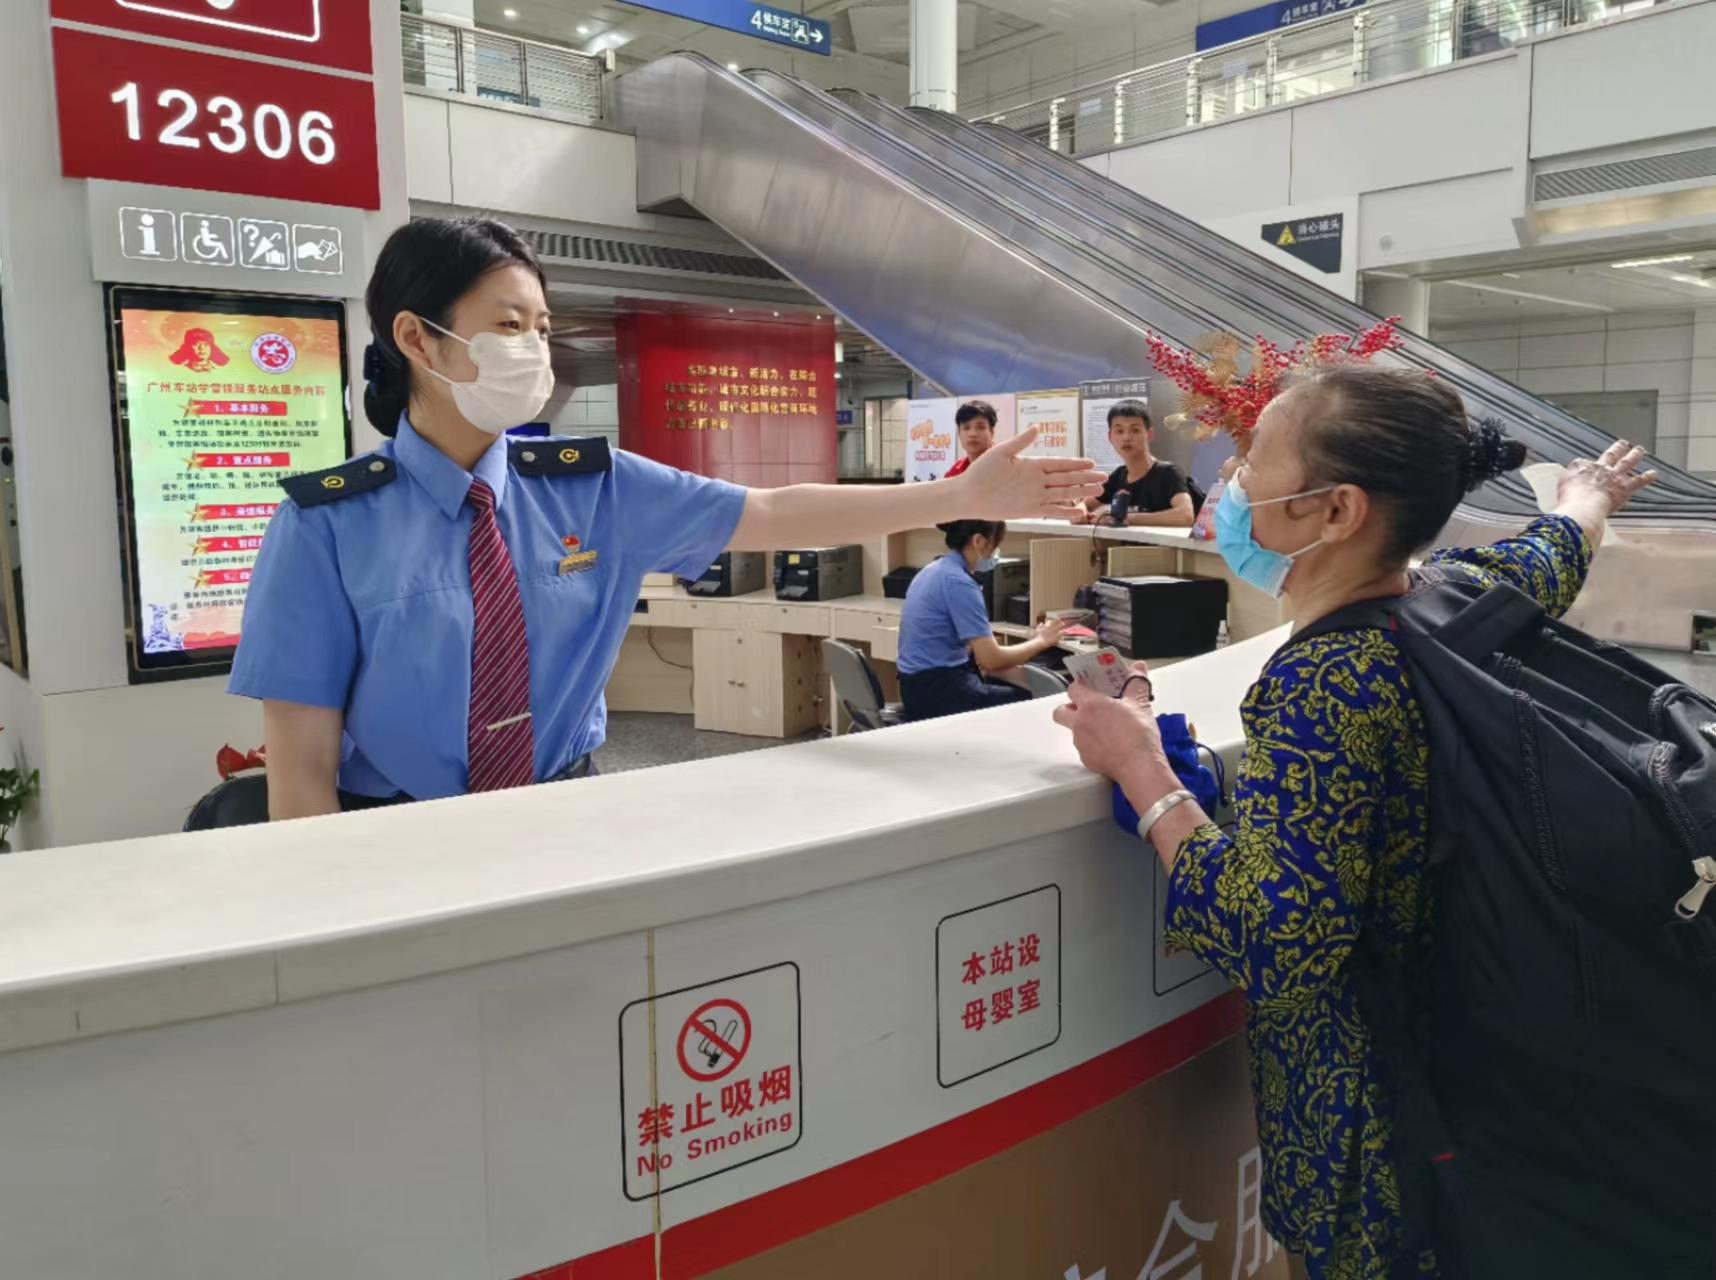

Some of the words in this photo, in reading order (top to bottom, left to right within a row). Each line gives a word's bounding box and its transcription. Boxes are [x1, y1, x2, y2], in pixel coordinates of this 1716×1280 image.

[111, 82, 336, 165] 12306
[961, 932, 1040, 985] 本站设
[961, 979, 1040, 1033] 母婴室
[637, 1065, 792, 1147] 禁止吸烟
[637, 1153, 672, 1177] No
[687, 1111, 793, 1161] Smoking
